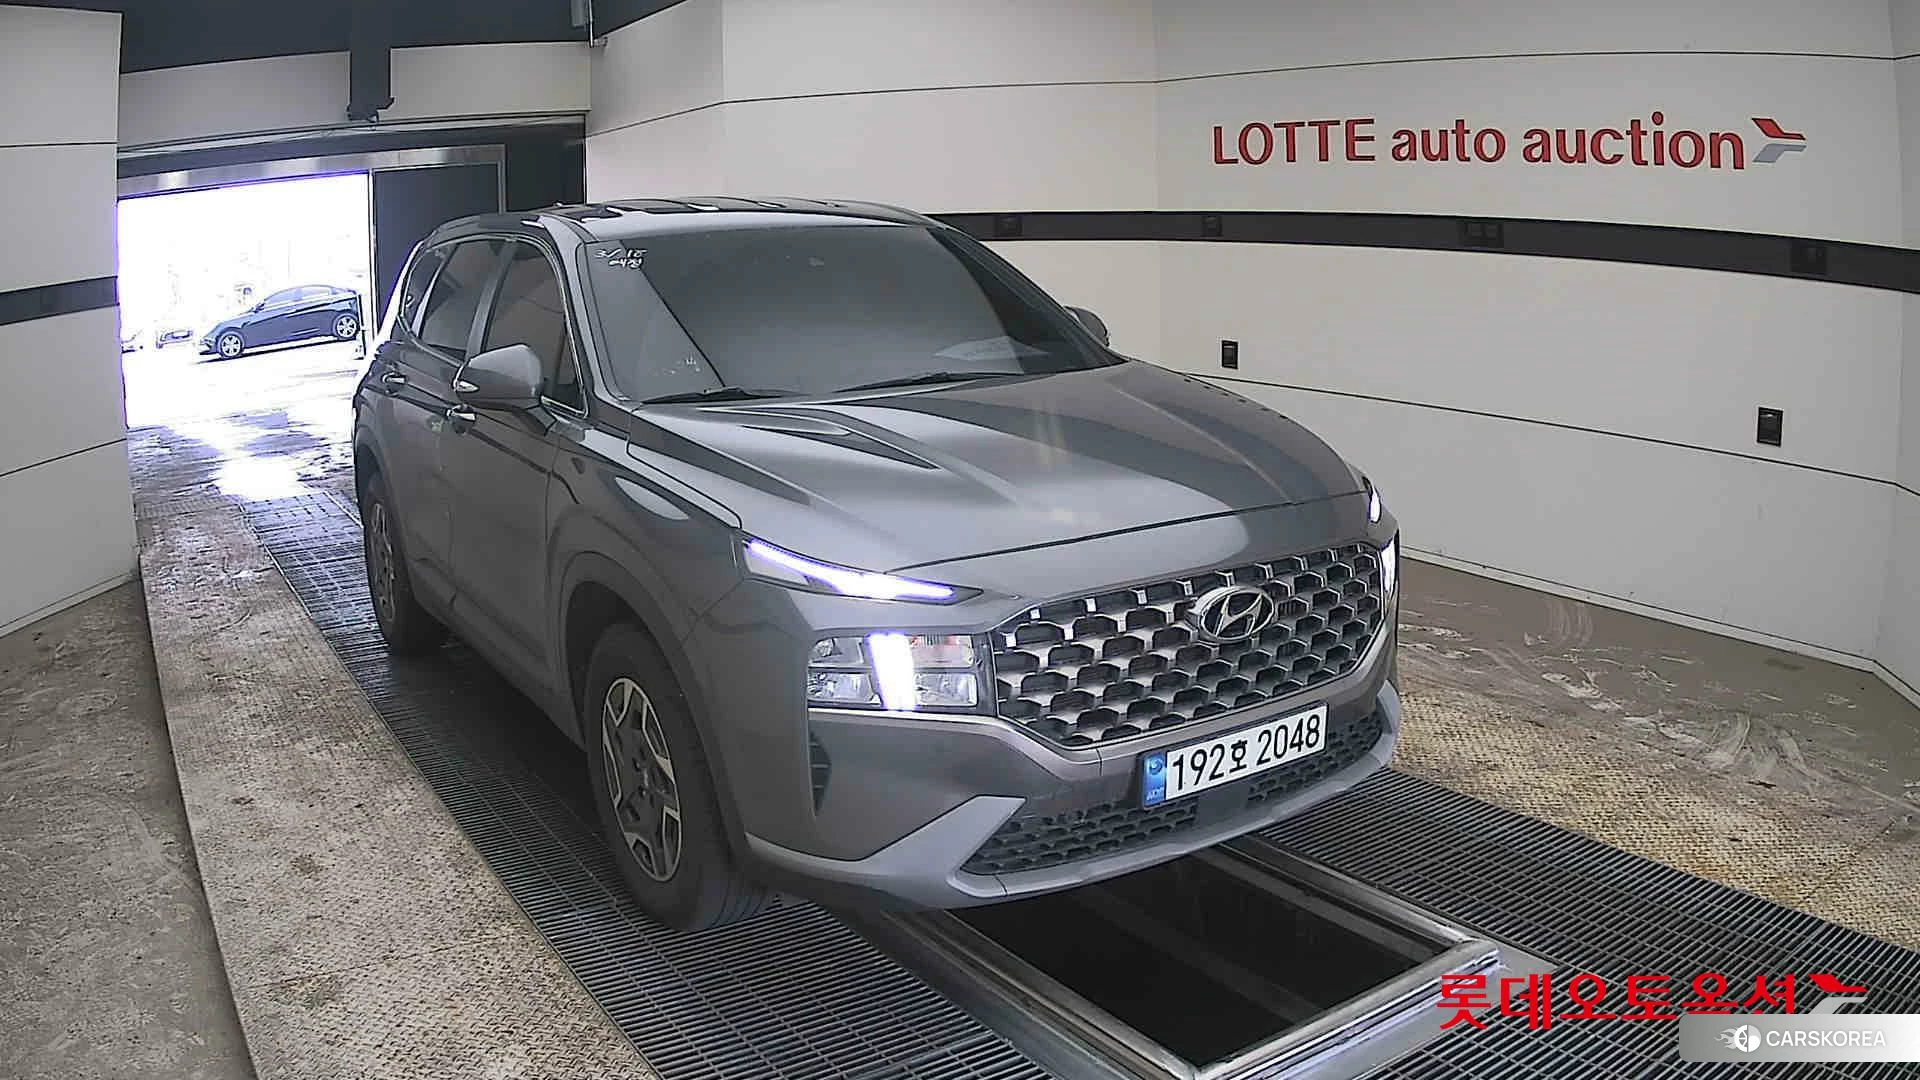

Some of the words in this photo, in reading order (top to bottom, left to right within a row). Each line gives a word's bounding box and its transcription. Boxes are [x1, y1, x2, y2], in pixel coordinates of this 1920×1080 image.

[1213, 118, 1376, 165] LOTTE
[1391, 118, 1507, 163] auto
[1523, 111, 1746, 170] auction
[1172, 739, 1248, 791] 192호
[1255, 713, 1321, 767] 2048
